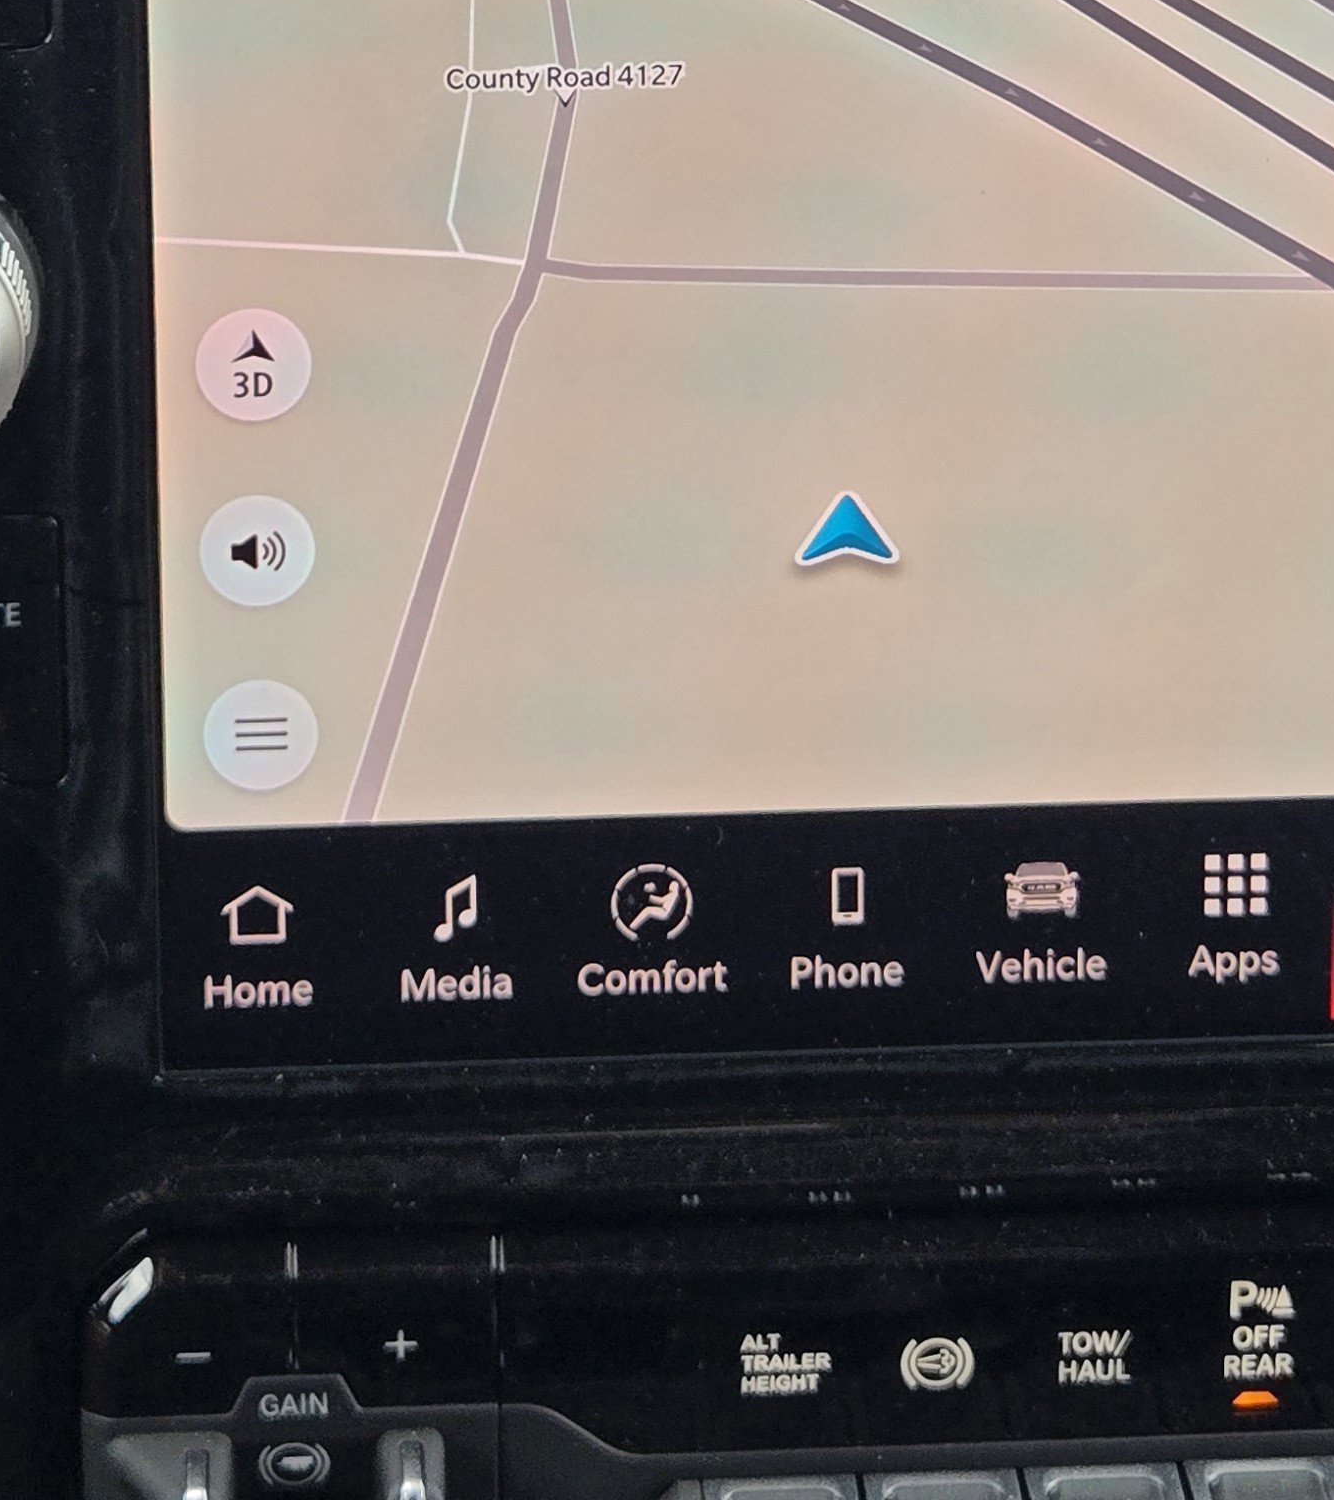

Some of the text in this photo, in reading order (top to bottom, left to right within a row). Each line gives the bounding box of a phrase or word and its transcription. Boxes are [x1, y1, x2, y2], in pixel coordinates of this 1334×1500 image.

[446, 64, 684, 93] County Road 4127
[233, 371, 273, 398] 3D
[577, 960, 729, 996] Comfort
[790, 955, 905, 989] Phone
[975, 947, 1108, 984] Vehicle
[1188, 945, 1280, 984] Apps
[203, 975, 314, 1009] Home
[400, 966, 514, 1002] Media
[740, 1332, 781, 1354] ALT
[1058, 1329, 1132, 1357] TOW/
[1232, 1324, 1286, 1352] OFF
[741, 1352, 831, 1374] TRAILER
[1058, 1358, 1131, 1386] HAUL
[1224, 1352, 1295, 1380] REAR
[740, 1372, 820, 1397] HEIGHT
[258, 1391, 330, 1421] GAIN
